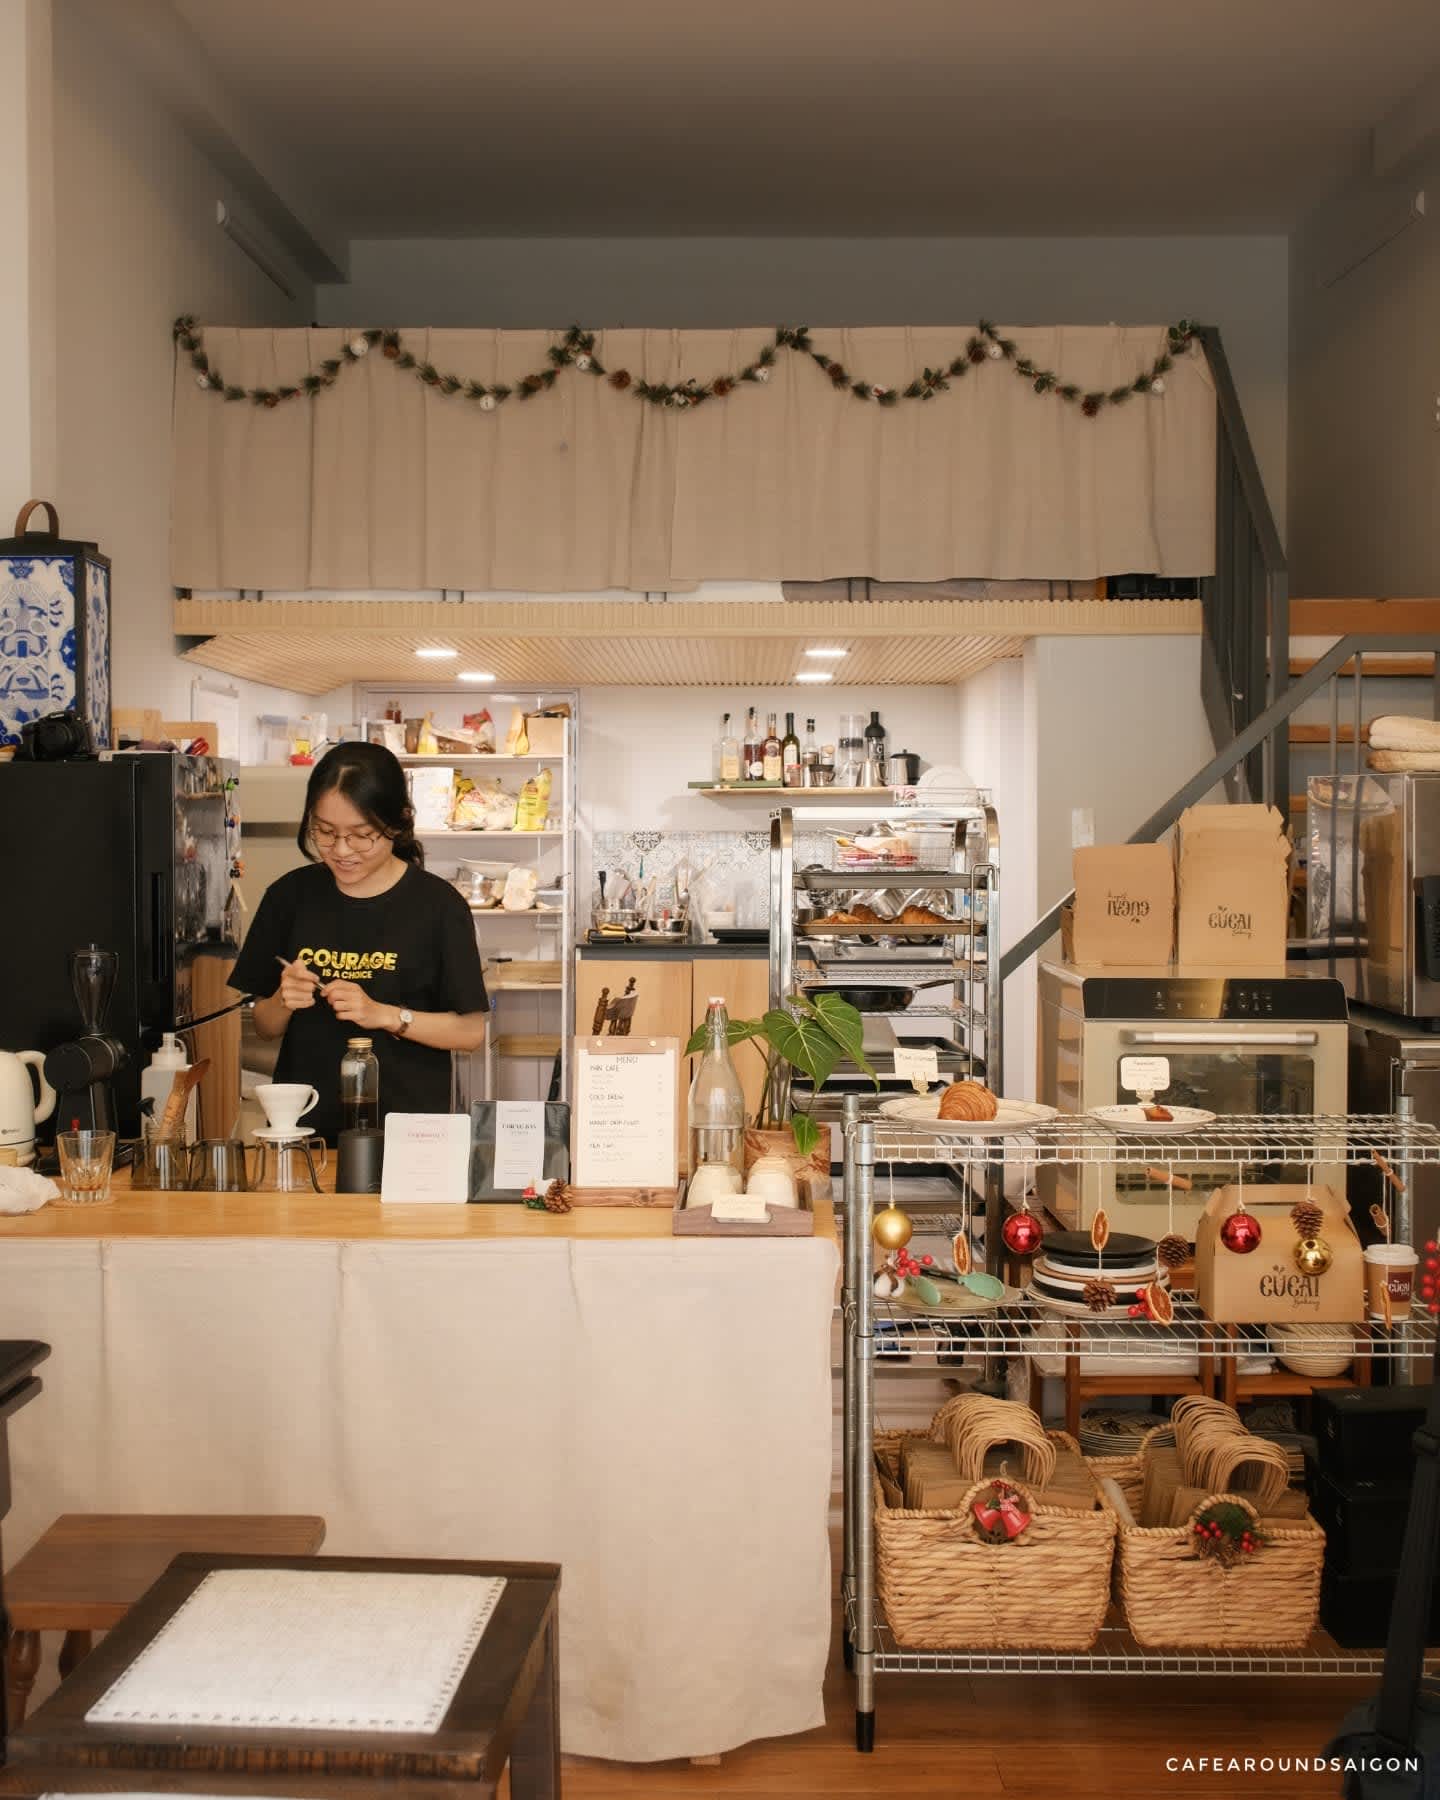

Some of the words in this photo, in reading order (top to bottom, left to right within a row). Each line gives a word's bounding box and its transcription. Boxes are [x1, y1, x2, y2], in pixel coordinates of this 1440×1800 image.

[297, 947, 398, 971] COURAGE
[322, 968, 331, 977] IS
[332, 970, 340, 978] A
[341, 970, 373, 979] CHOICE
